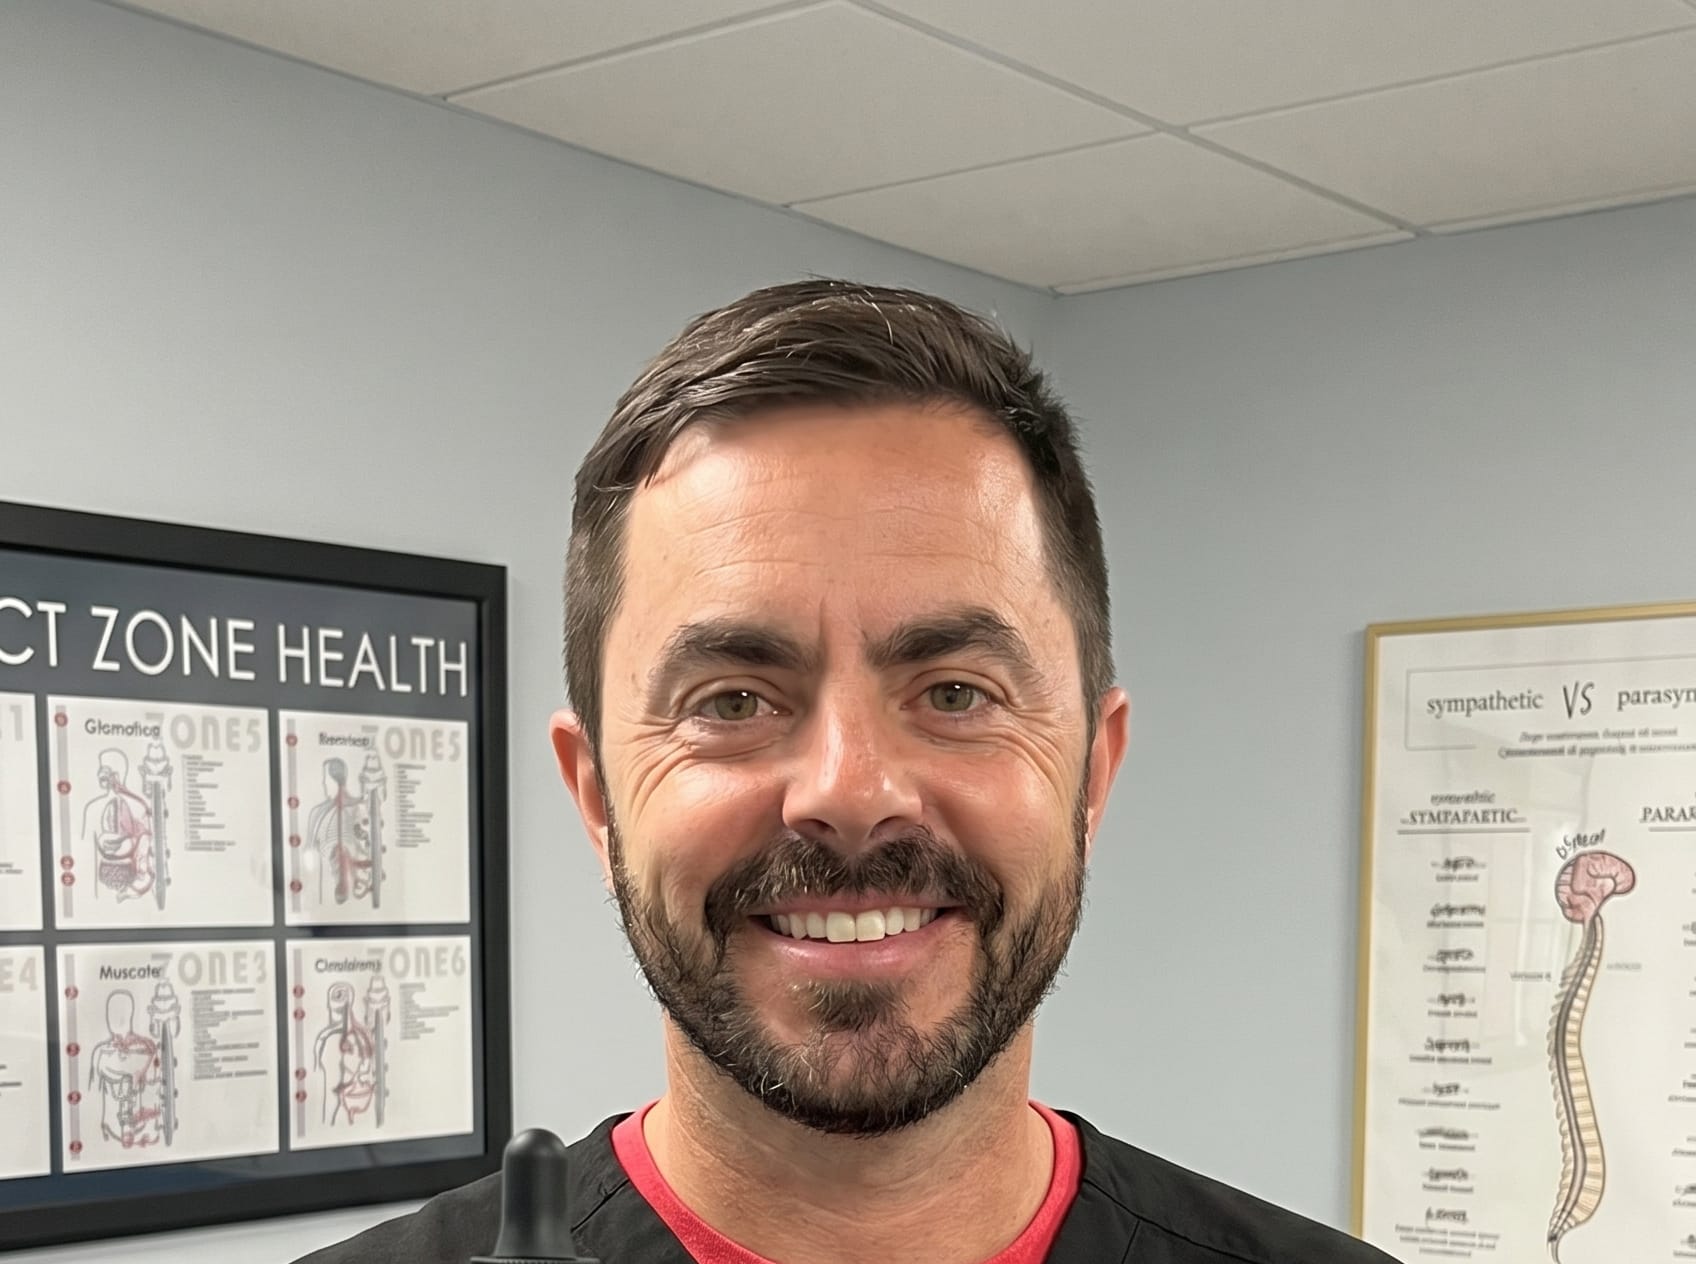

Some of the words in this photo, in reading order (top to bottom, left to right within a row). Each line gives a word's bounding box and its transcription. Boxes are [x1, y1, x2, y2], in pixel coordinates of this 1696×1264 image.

[91, 605, 255, 680] ZONE
[278, 623, 467, 697] HEALTH
[1426, 689, 1544, 719] sympathetic
[1562, 681, 1594, 719] VS
